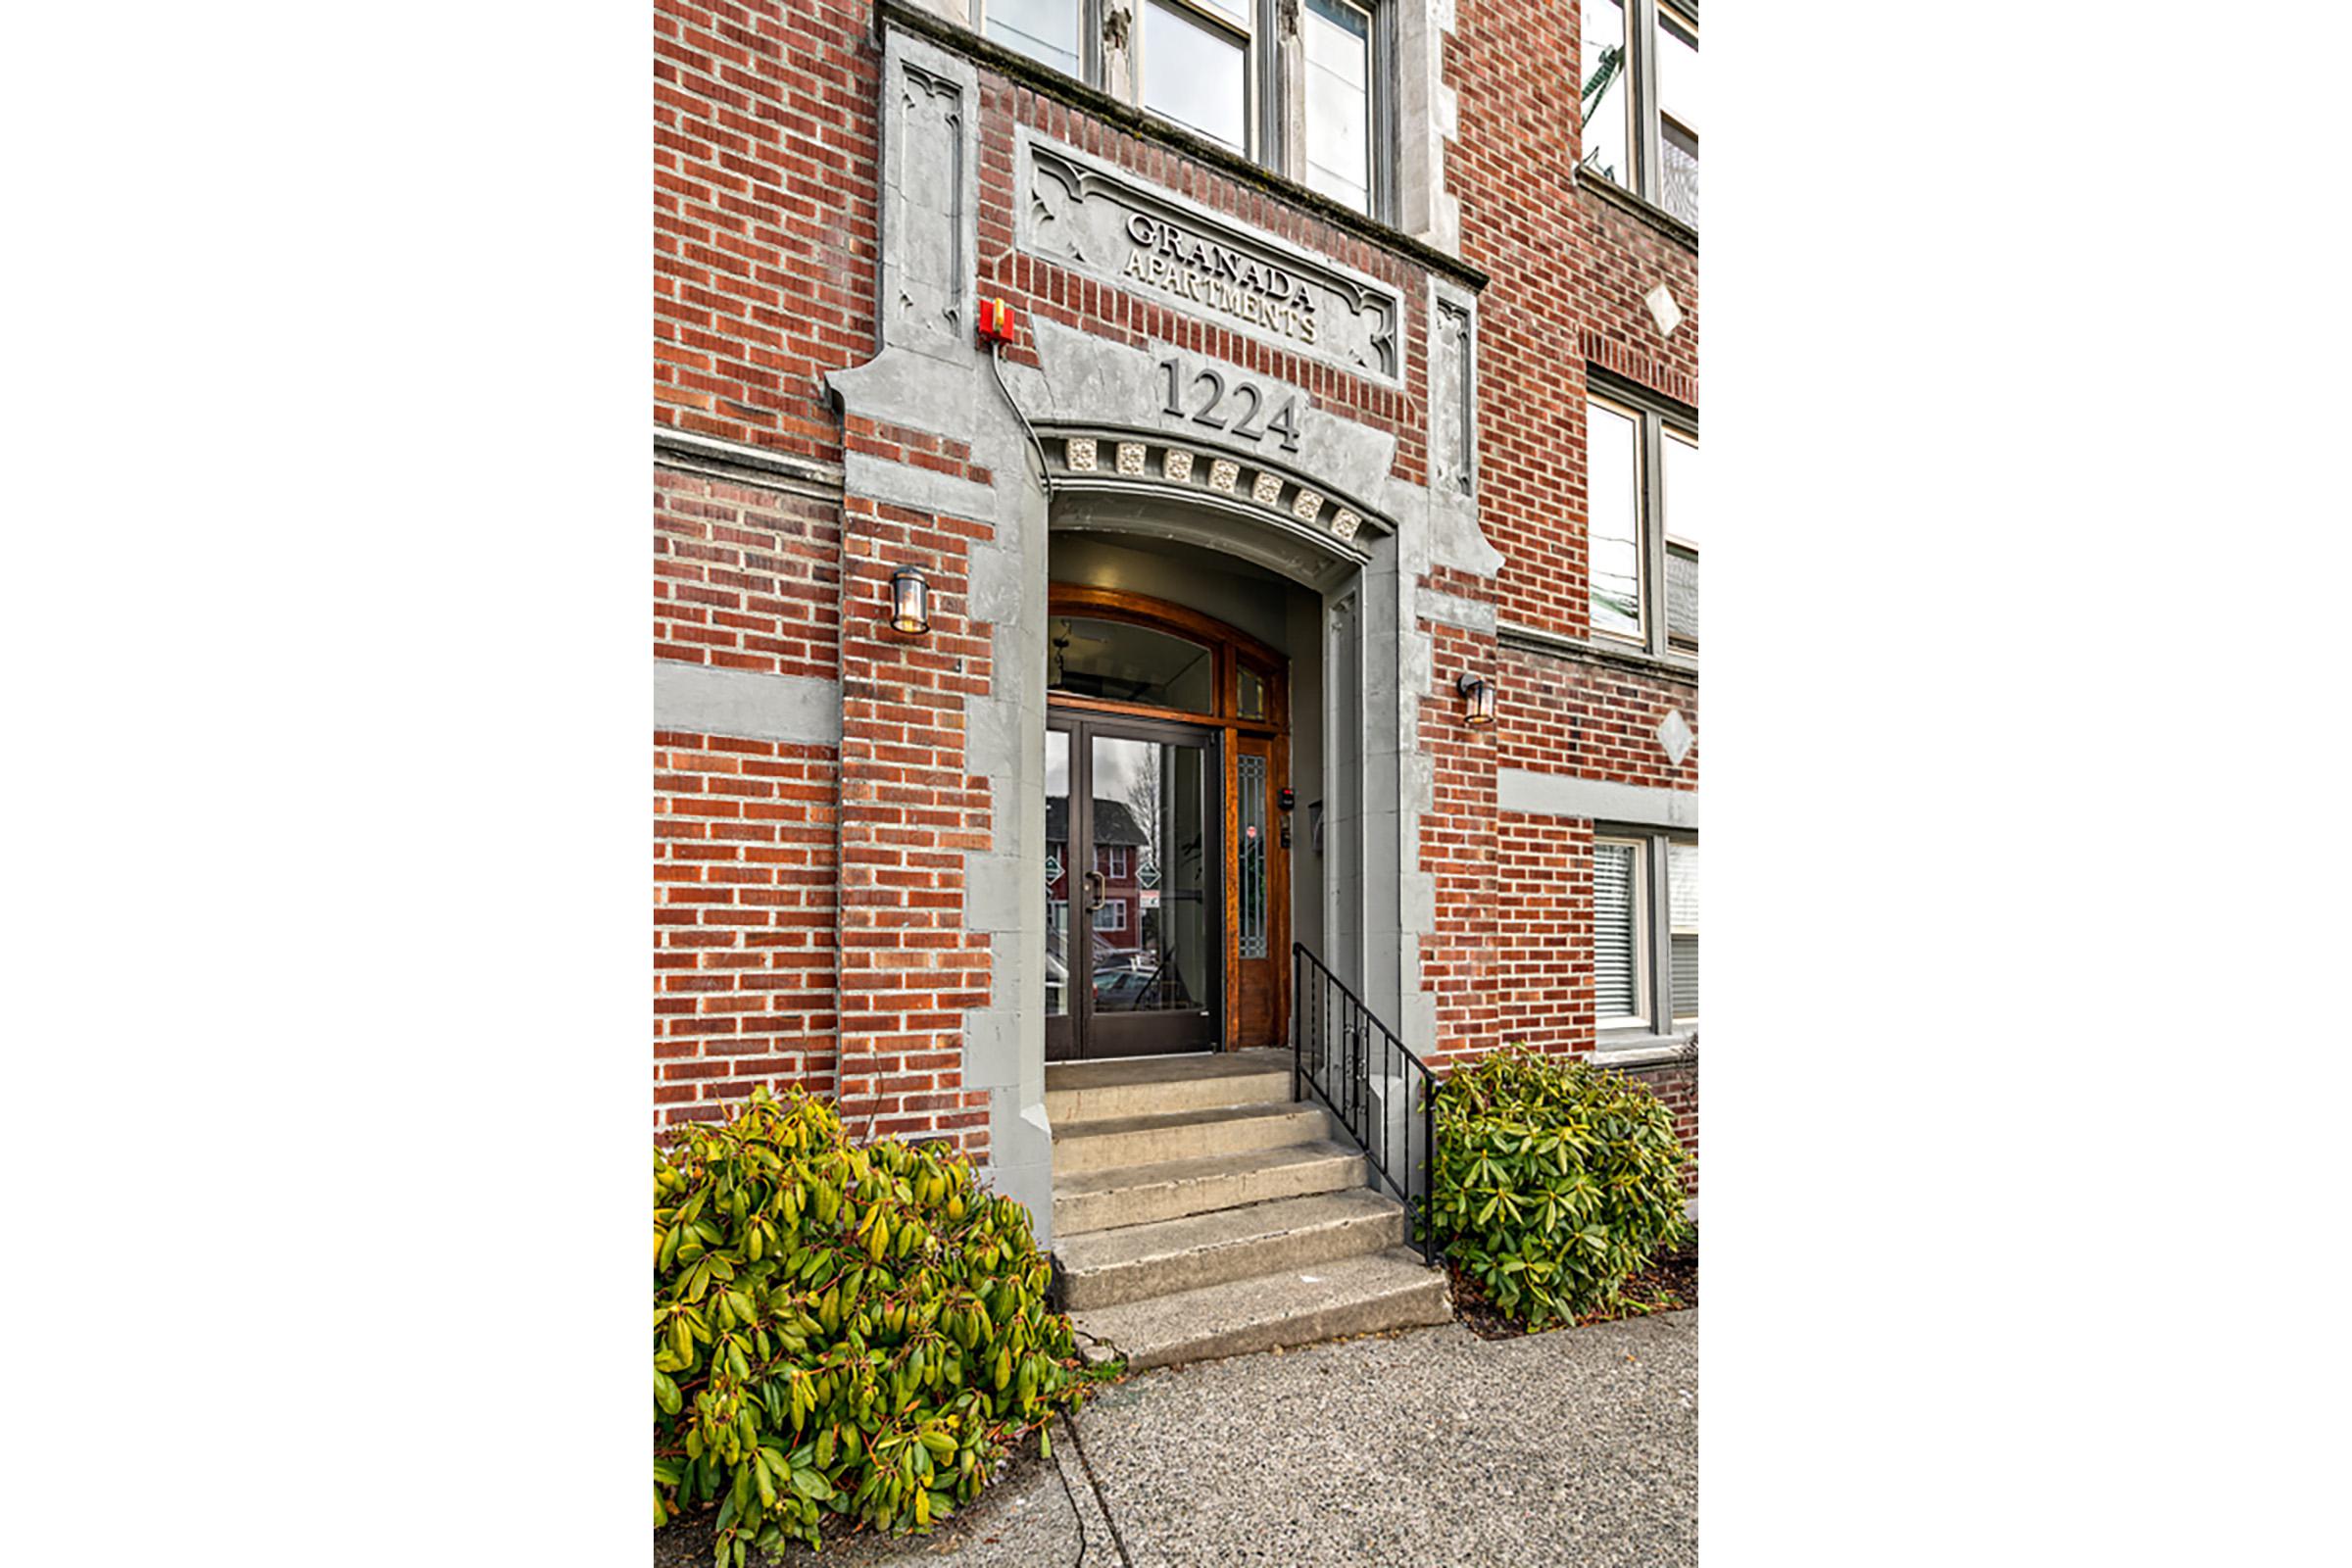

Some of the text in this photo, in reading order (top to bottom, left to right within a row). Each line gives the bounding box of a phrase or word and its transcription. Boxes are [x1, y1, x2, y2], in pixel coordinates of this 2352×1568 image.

[1124, 249, 1318, 345] APARTMENTS
[1127, 213, 1315, 313] GRANADA
[1160, 359, 1300, 453] 1224
